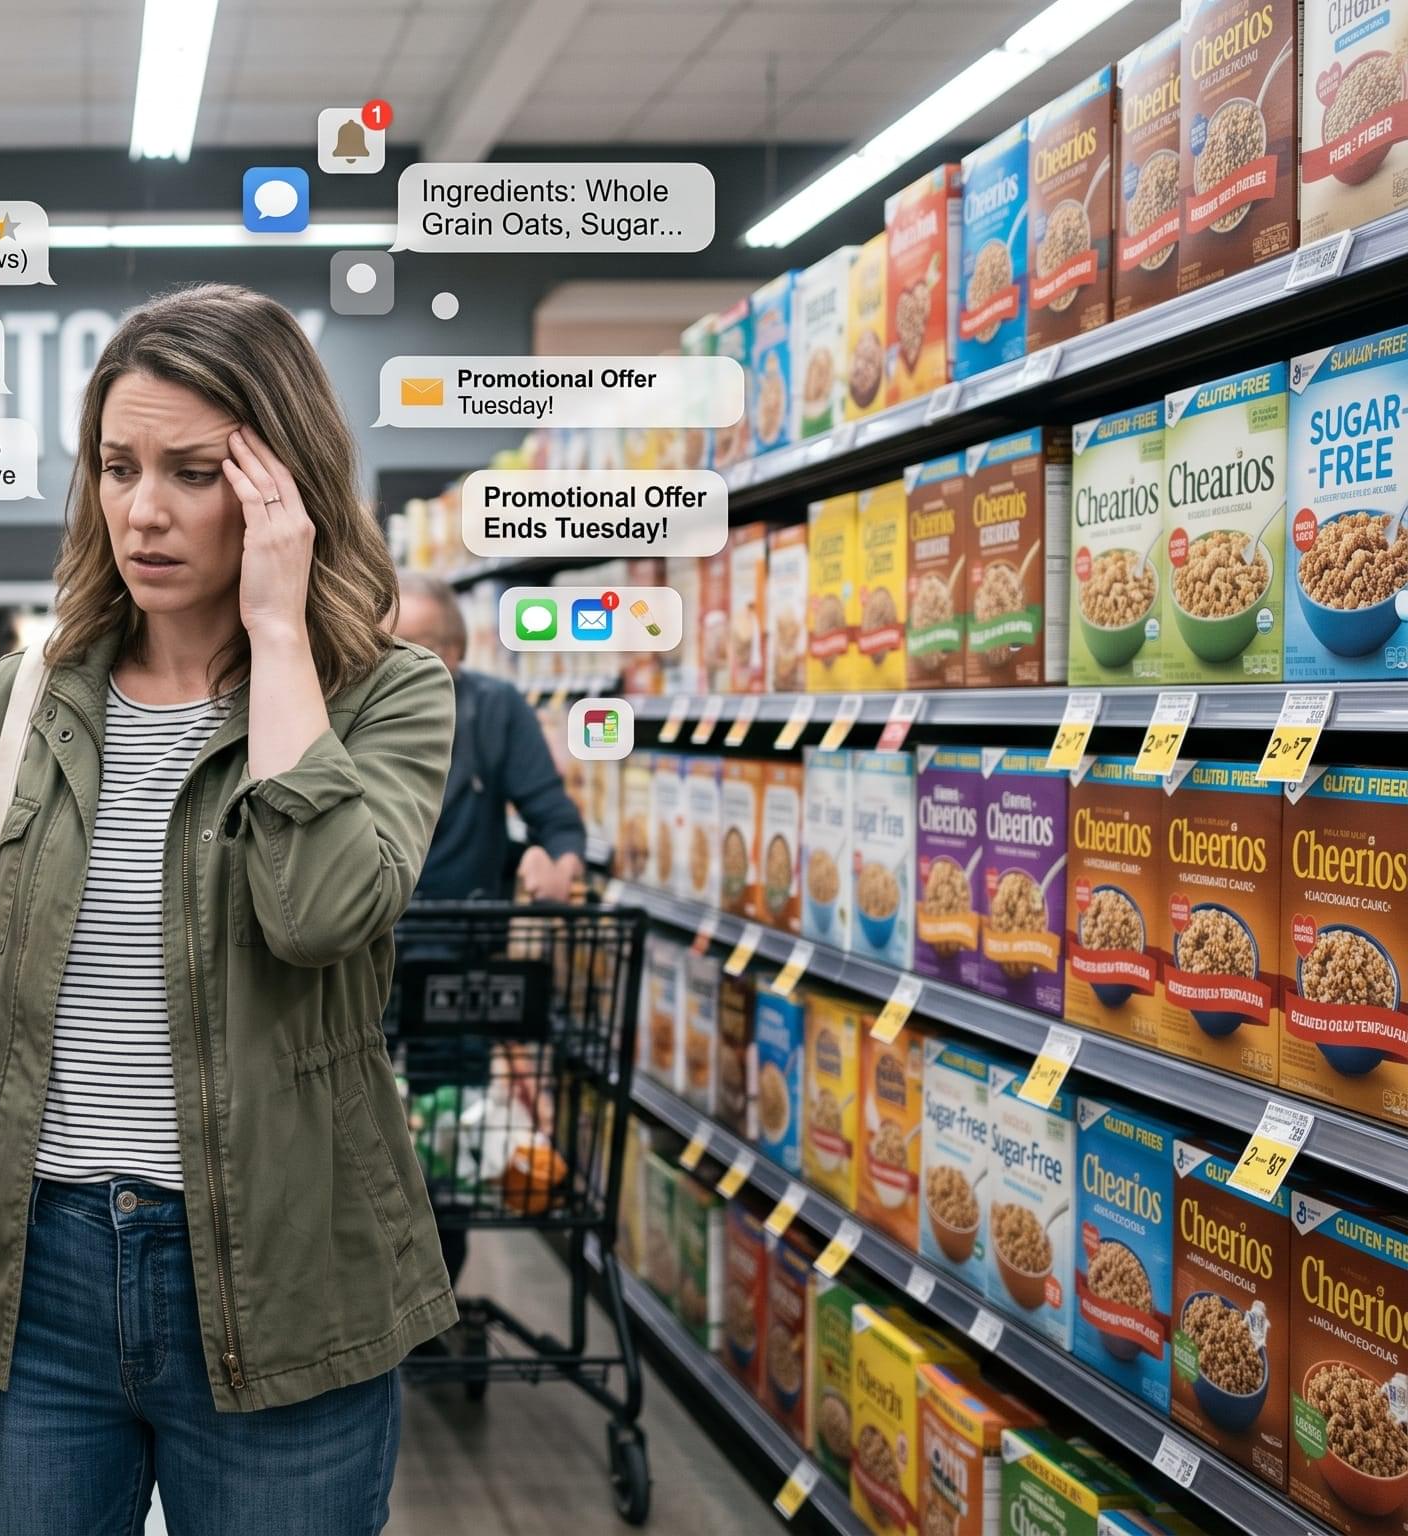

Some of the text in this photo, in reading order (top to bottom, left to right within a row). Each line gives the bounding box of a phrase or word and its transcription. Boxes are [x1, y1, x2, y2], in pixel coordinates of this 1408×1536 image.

[1190, 3, 1273, 82] Cheerios
[1034, 126, 1096, 185] Cheerios
[1357, 117, 1393, 149] FIBER
[1197, 373, 1271, 409] GLUTEN-FREE
[1143, 734, 1156, 754] 2
[1267, 737, 1283, 759] 2
[986, 802, 1054, 847] Cheerios
[1074, 808, 1152, 857] Cheerios
[1169, 818, 1266, 873] Cheerios
[1292, 830, 1407, 892] Cheerios
[1243, 1146, 1258, 1166] 2
[1082, 1153, 1162, 1224] Chearios
[1180, 1198, 1273, 1280] Cheerios
